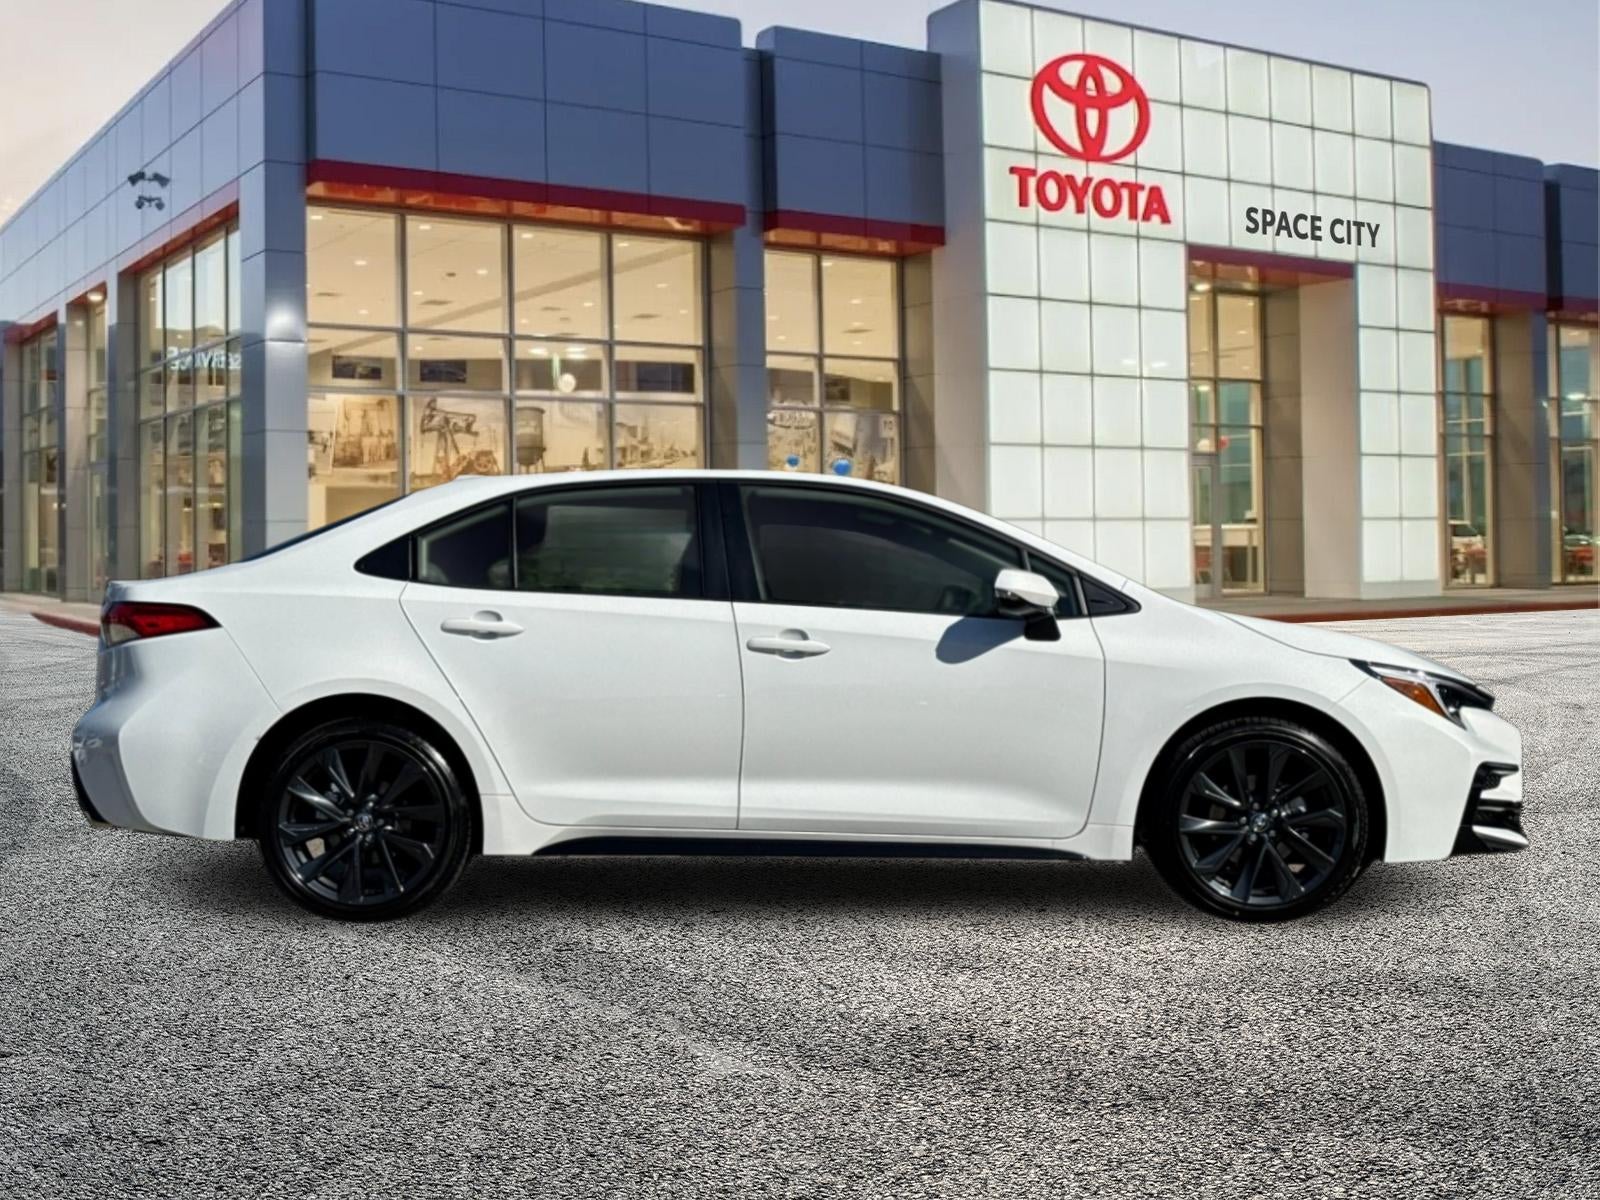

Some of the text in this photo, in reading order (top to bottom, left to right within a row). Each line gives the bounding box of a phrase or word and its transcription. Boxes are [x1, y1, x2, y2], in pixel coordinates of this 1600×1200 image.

[1010, 166, 1171, 224] TOYOTA
[1245, 206, 1380, 248] SPACE CITY
